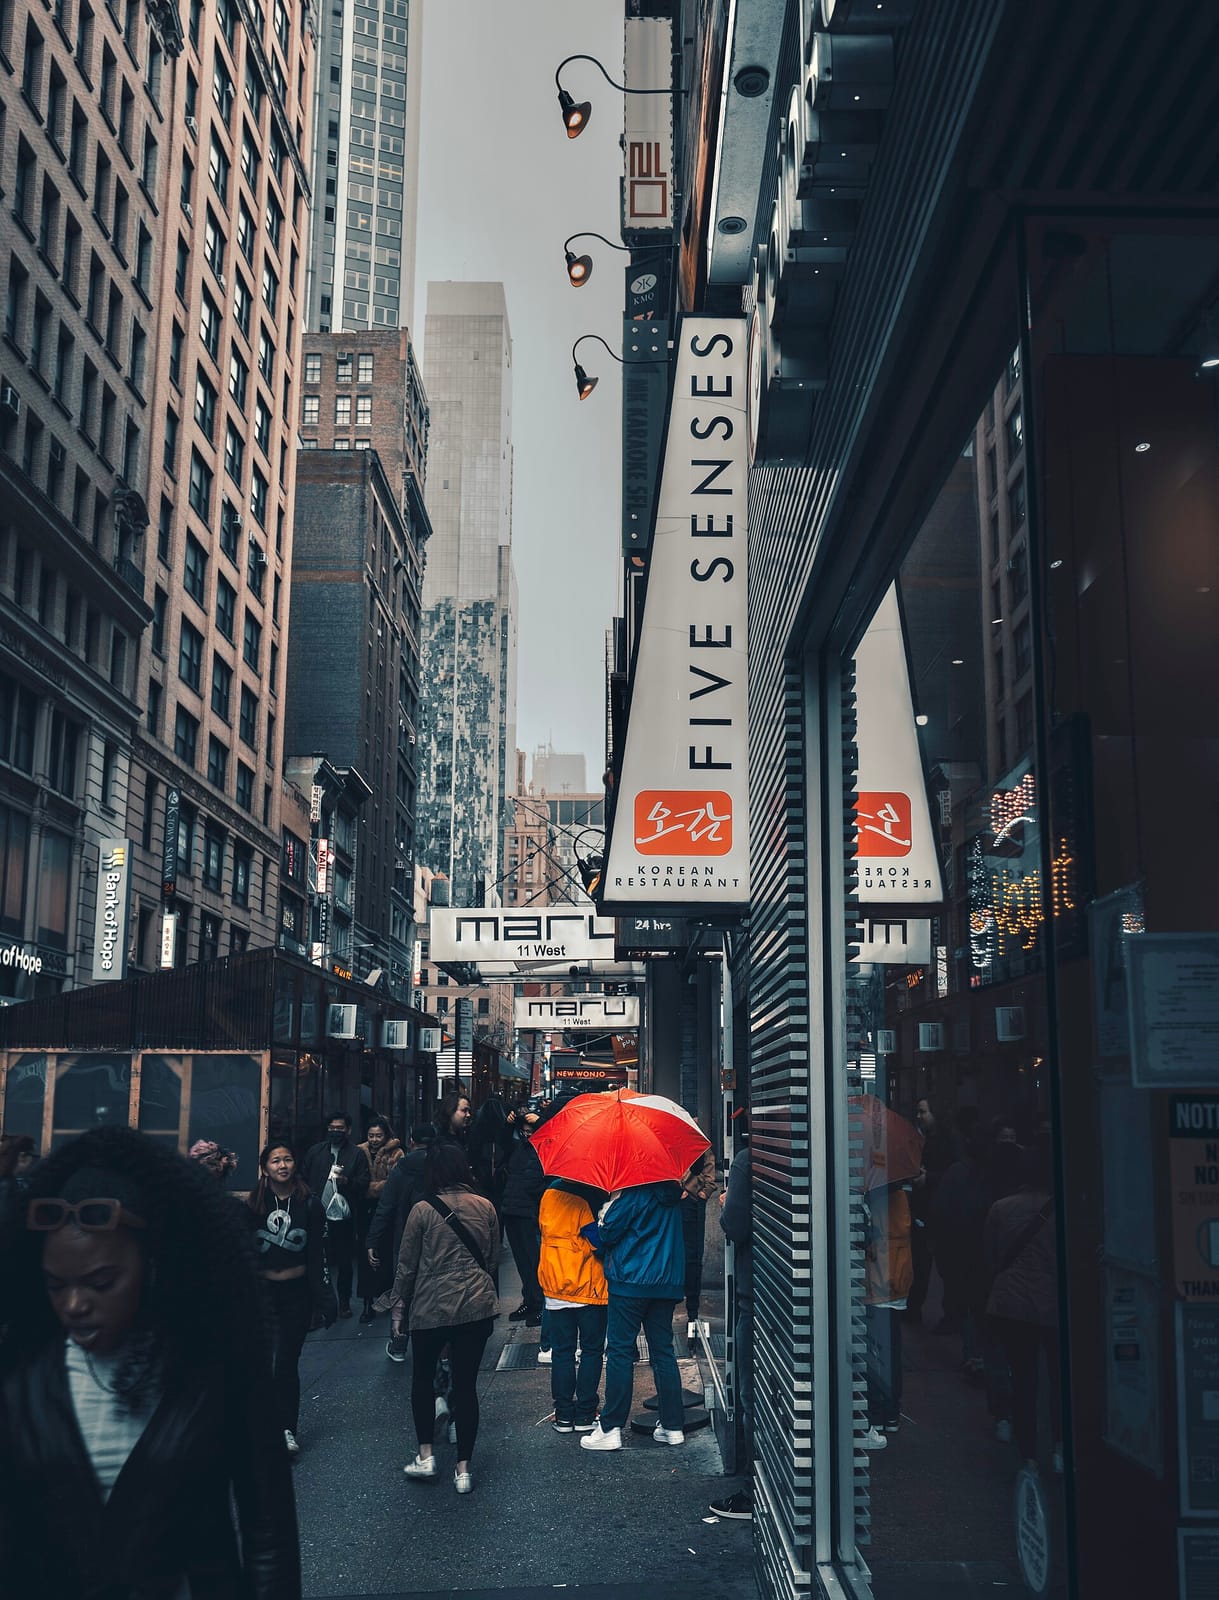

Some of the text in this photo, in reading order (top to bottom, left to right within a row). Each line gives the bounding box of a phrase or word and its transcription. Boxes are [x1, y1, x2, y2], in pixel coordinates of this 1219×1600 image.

[689, 333, 734, 770] FIVE SENSES
[635, 801, 732, 845] 오감
[319, 850, 327, 872] NAIL
[637, 865, 714, 876] KOREAN
[105, 872, 121, 909] Bank
[615, 877, 740, 888] RESTAURANT
[634, 919, 650, 931] 24
[100, 929, 118, 971] Hope
[517, 945, 566, 957] 11 West
[2, 945, 17, 967] of
[15, 946, 43, 976] Hope
[528, 1000, 626, 1017] maru
[572, 1018, 591, 1026] West
[556, 1070, 606, 1079] NEW WONJO
